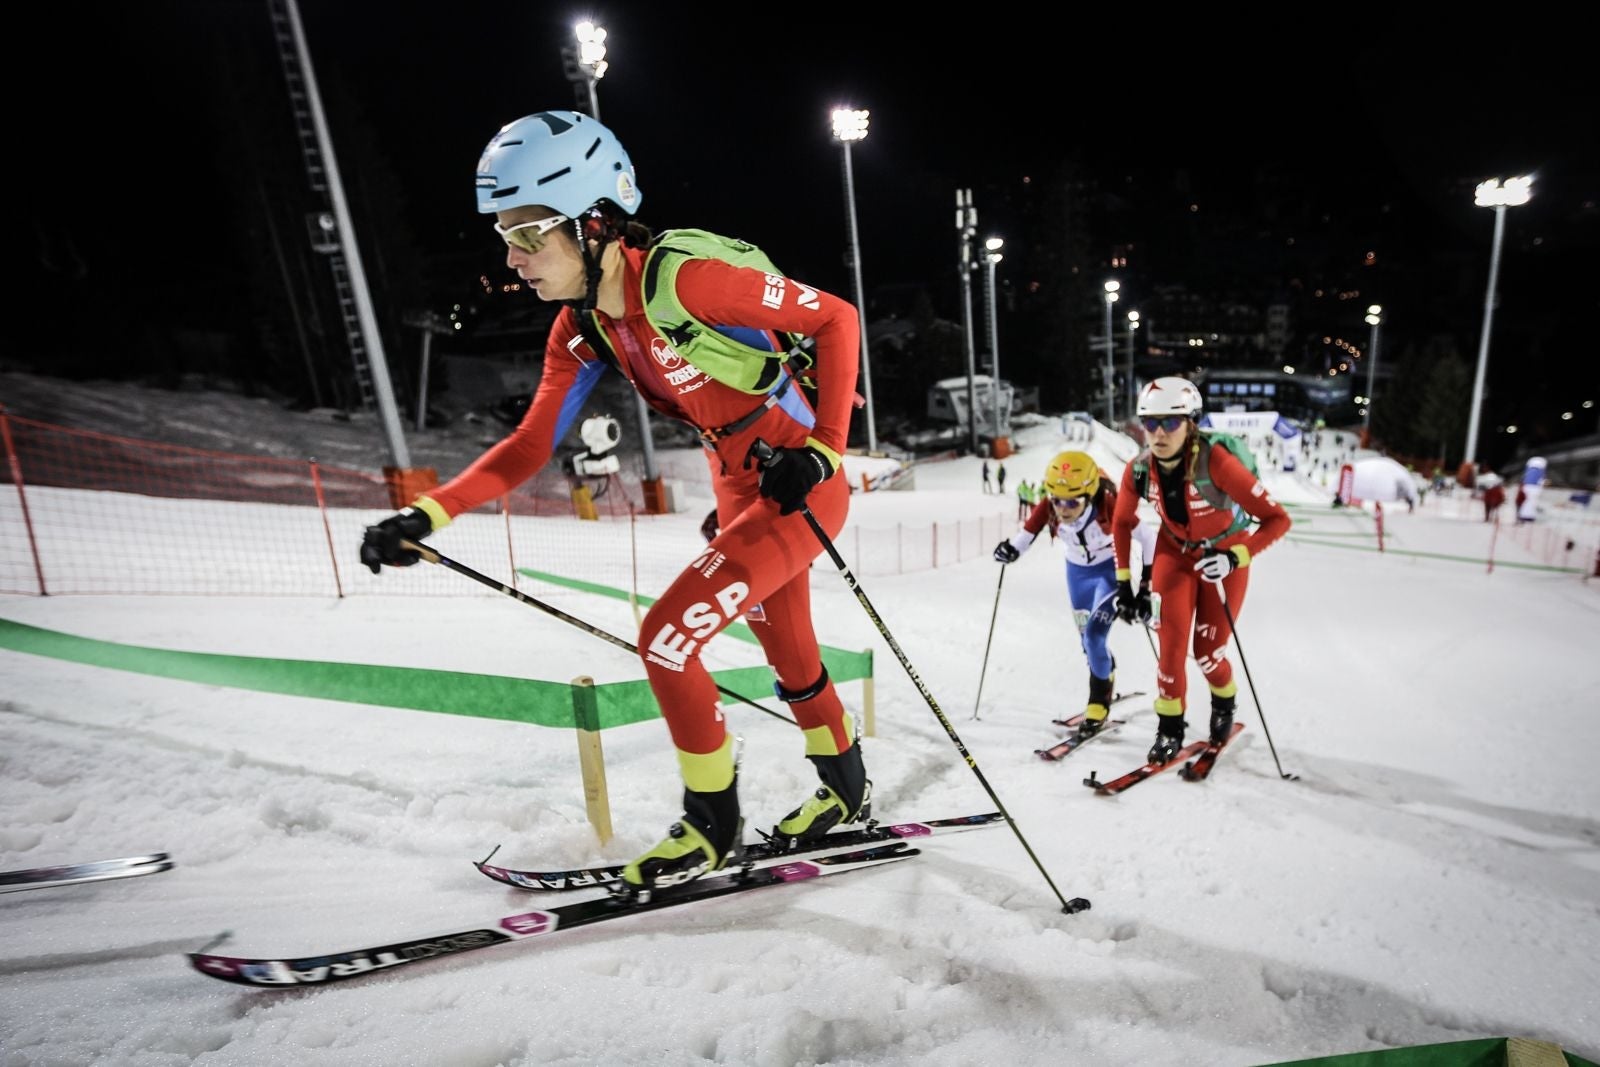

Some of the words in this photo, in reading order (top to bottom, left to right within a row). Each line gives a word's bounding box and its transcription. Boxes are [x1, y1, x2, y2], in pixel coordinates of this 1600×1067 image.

[761, 271, 786, 307] ES
[703, 553, 727, 579] MILLET
[647, 581, 750, 667] ESP
